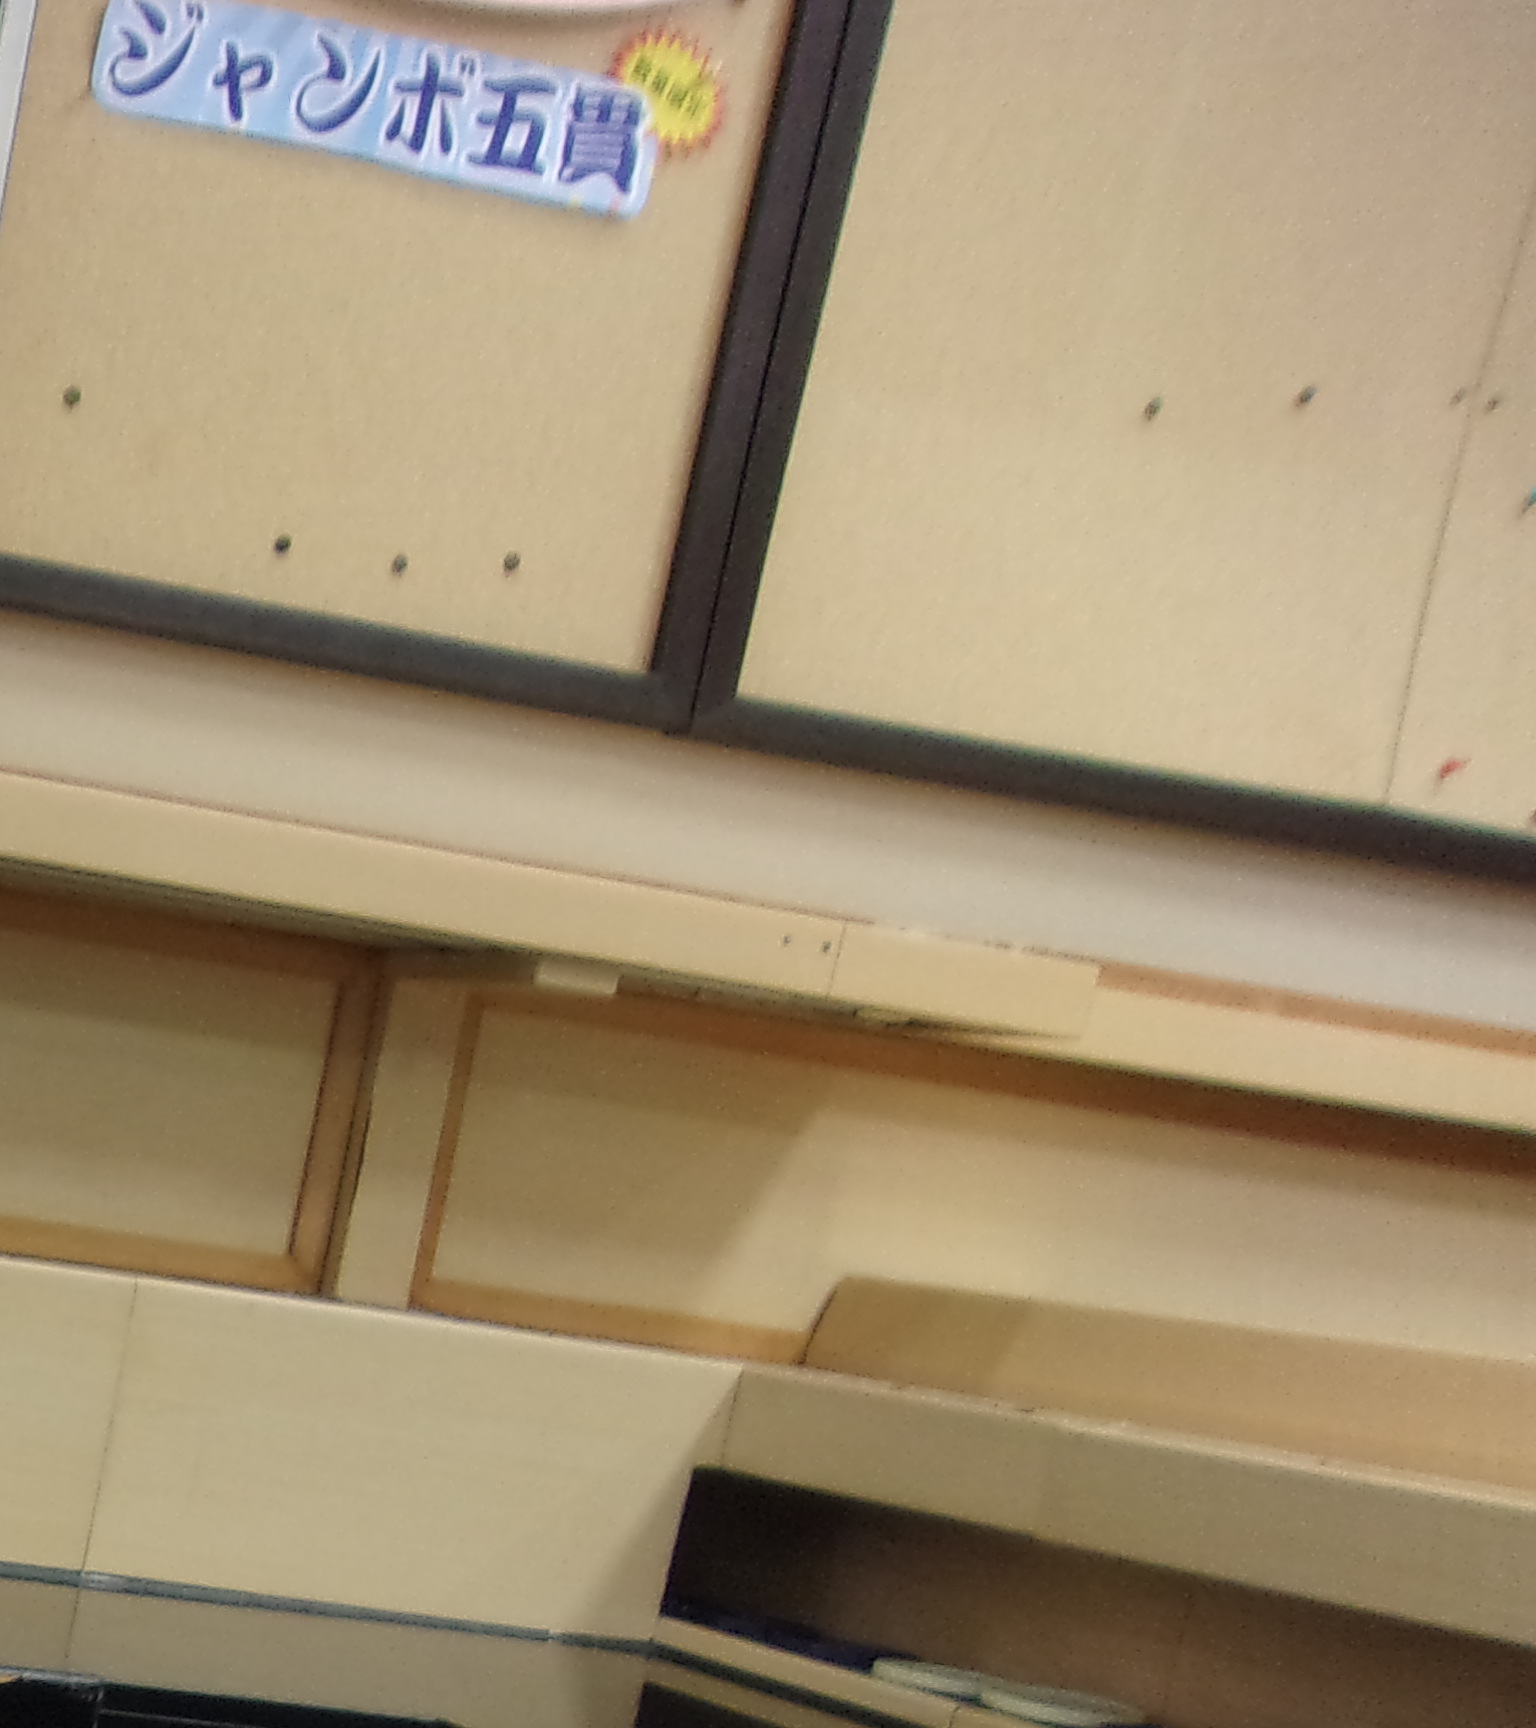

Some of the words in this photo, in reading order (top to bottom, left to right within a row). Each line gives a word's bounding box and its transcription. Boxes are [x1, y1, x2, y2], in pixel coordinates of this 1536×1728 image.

[109, 0, 641, 194] ジャンボ五貫
